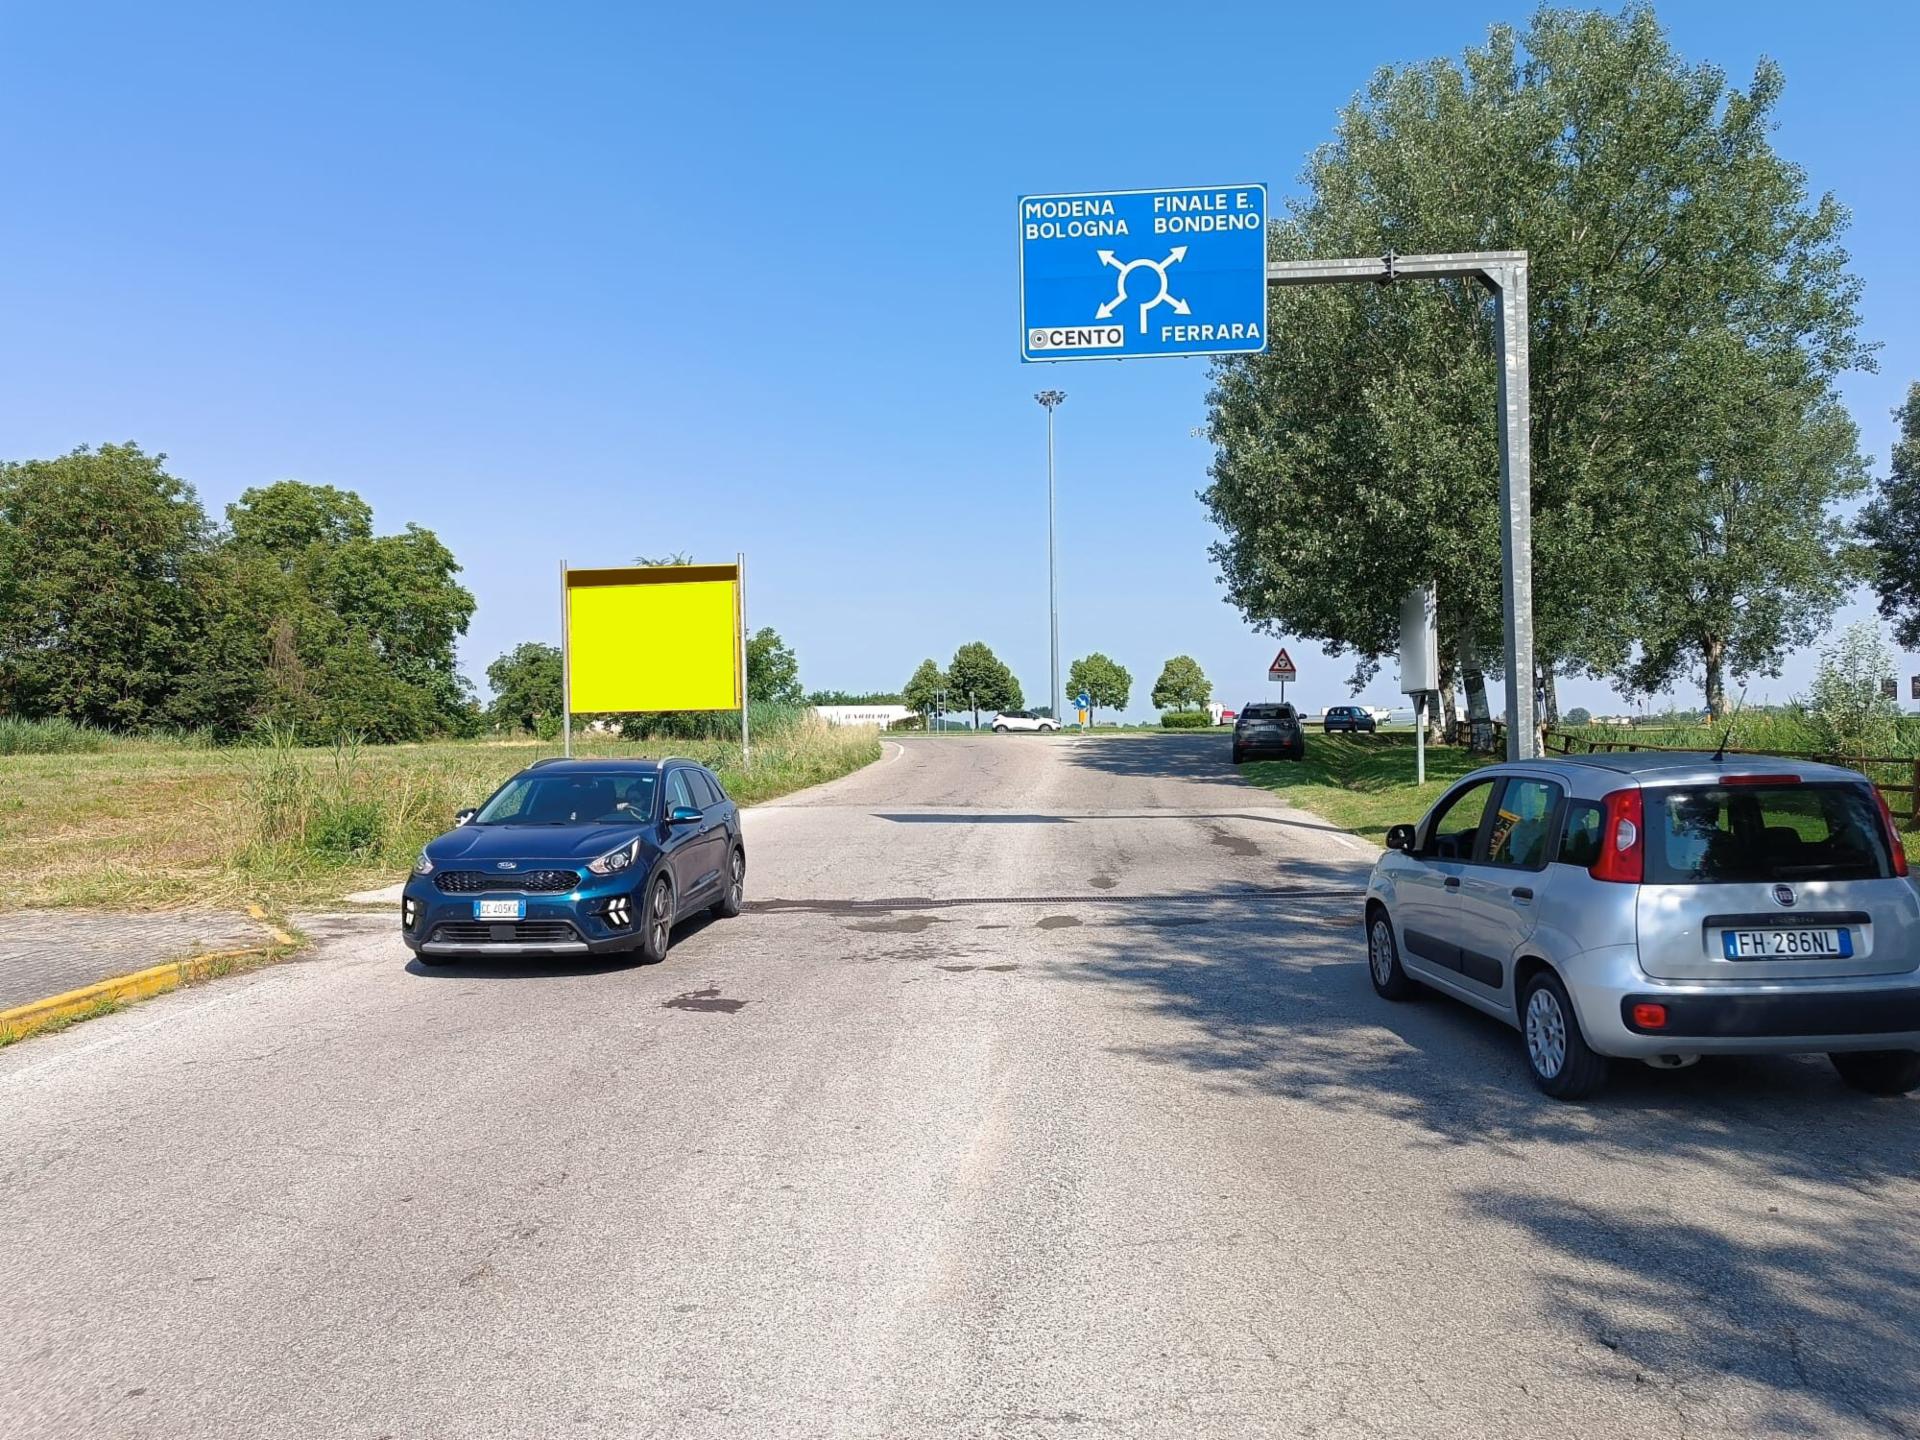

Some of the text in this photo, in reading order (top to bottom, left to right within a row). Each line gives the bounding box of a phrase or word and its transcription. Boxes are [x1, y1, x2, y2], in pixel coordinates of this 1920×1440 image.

[1025, 199, 1115, 219] MODENA
[1153, 192, 1254, 213] FINALE E.
[1025, 219, 1129, 240] BOLOGNA
[1154, 213, 1260, 234] BONDENO
[1049, 328, 1122, 346] CENTO
[1161, 322, 1260, 342] FERRARA
[1738, 933, 1766, 954] FH
[1773, 931, 1838, 953] 286NL
